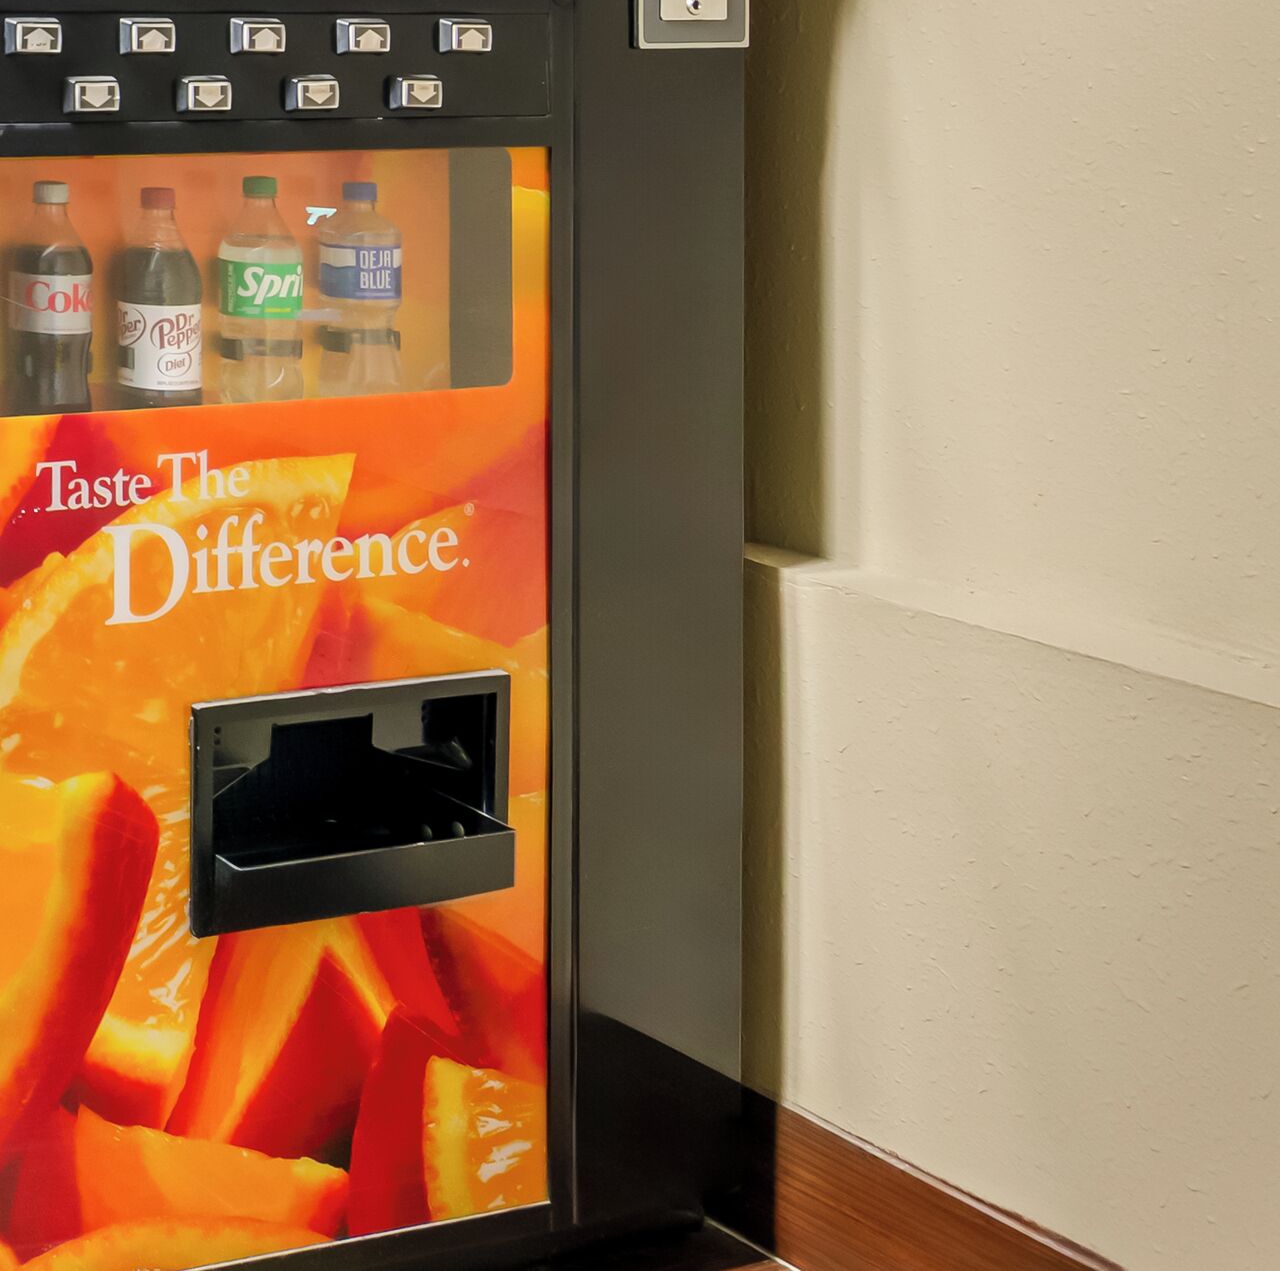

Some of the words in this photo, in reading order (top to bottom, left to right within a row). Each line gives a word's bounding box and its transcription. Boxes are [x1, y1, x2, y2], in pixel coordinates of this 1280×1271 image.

[359, 250, 392, 270] DEJA
[359, 270, 392, 289] BLUE
[175, 313, 195, 331] Dr
[165, 357, 186, 372] Diet
[157, 449, 250, 503] The
